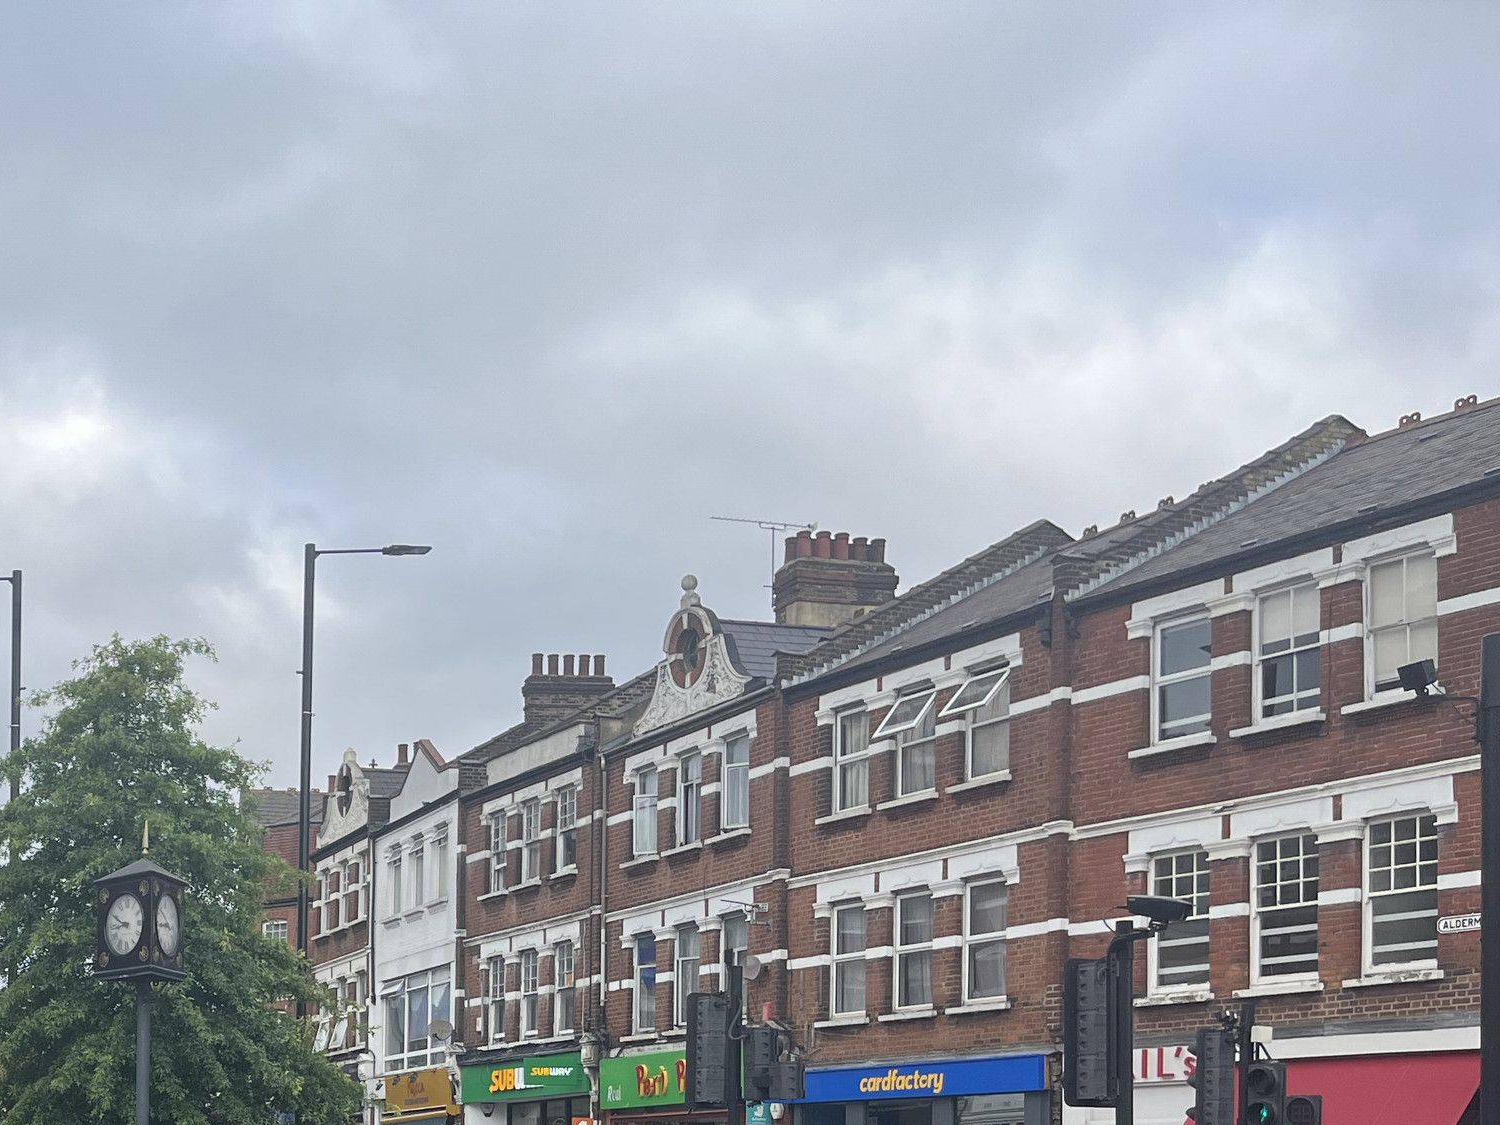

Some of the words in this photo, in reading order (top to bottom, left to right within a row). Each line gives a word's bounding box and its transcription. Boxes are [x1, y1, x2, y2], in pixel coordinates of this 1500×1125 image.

[1443, 918, 1482, 929] ALDERM
[530, 1067, 573, 1076] SUBWAY
[860, 1069, 944, 1094] cardfactory
